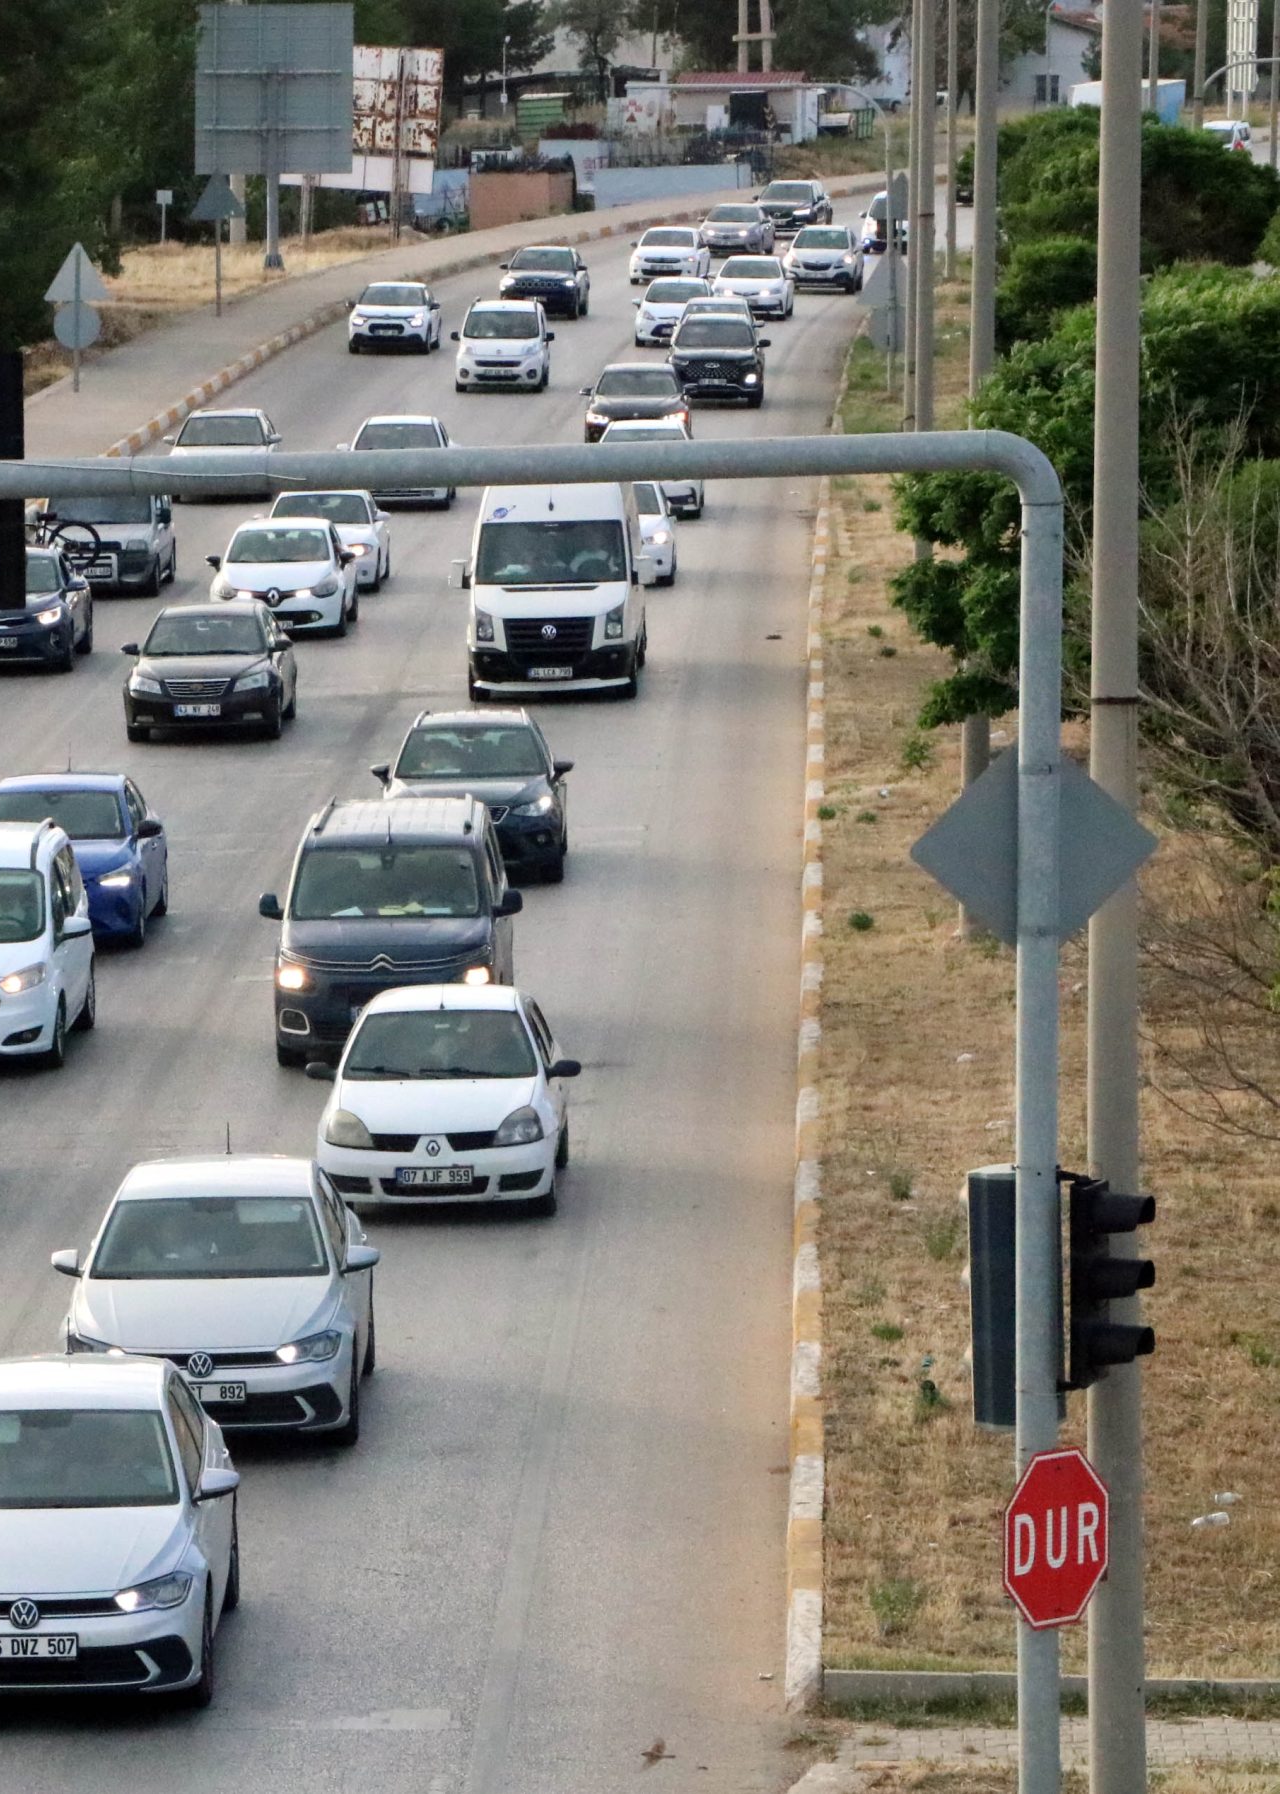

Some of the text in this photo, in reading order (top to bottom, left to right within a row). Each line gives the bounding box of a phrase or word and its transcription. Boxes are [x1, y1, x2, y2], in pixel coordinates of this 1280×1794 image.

[403, 1169, 470, 1183] 07 AJF 959
[220, 1385, 244, 1400] 892
[1014, 1501, 1100, 1576] DUR
[11, 1639, 39, 1656] DVZ
[47, 1638, 75, 1655] 507
